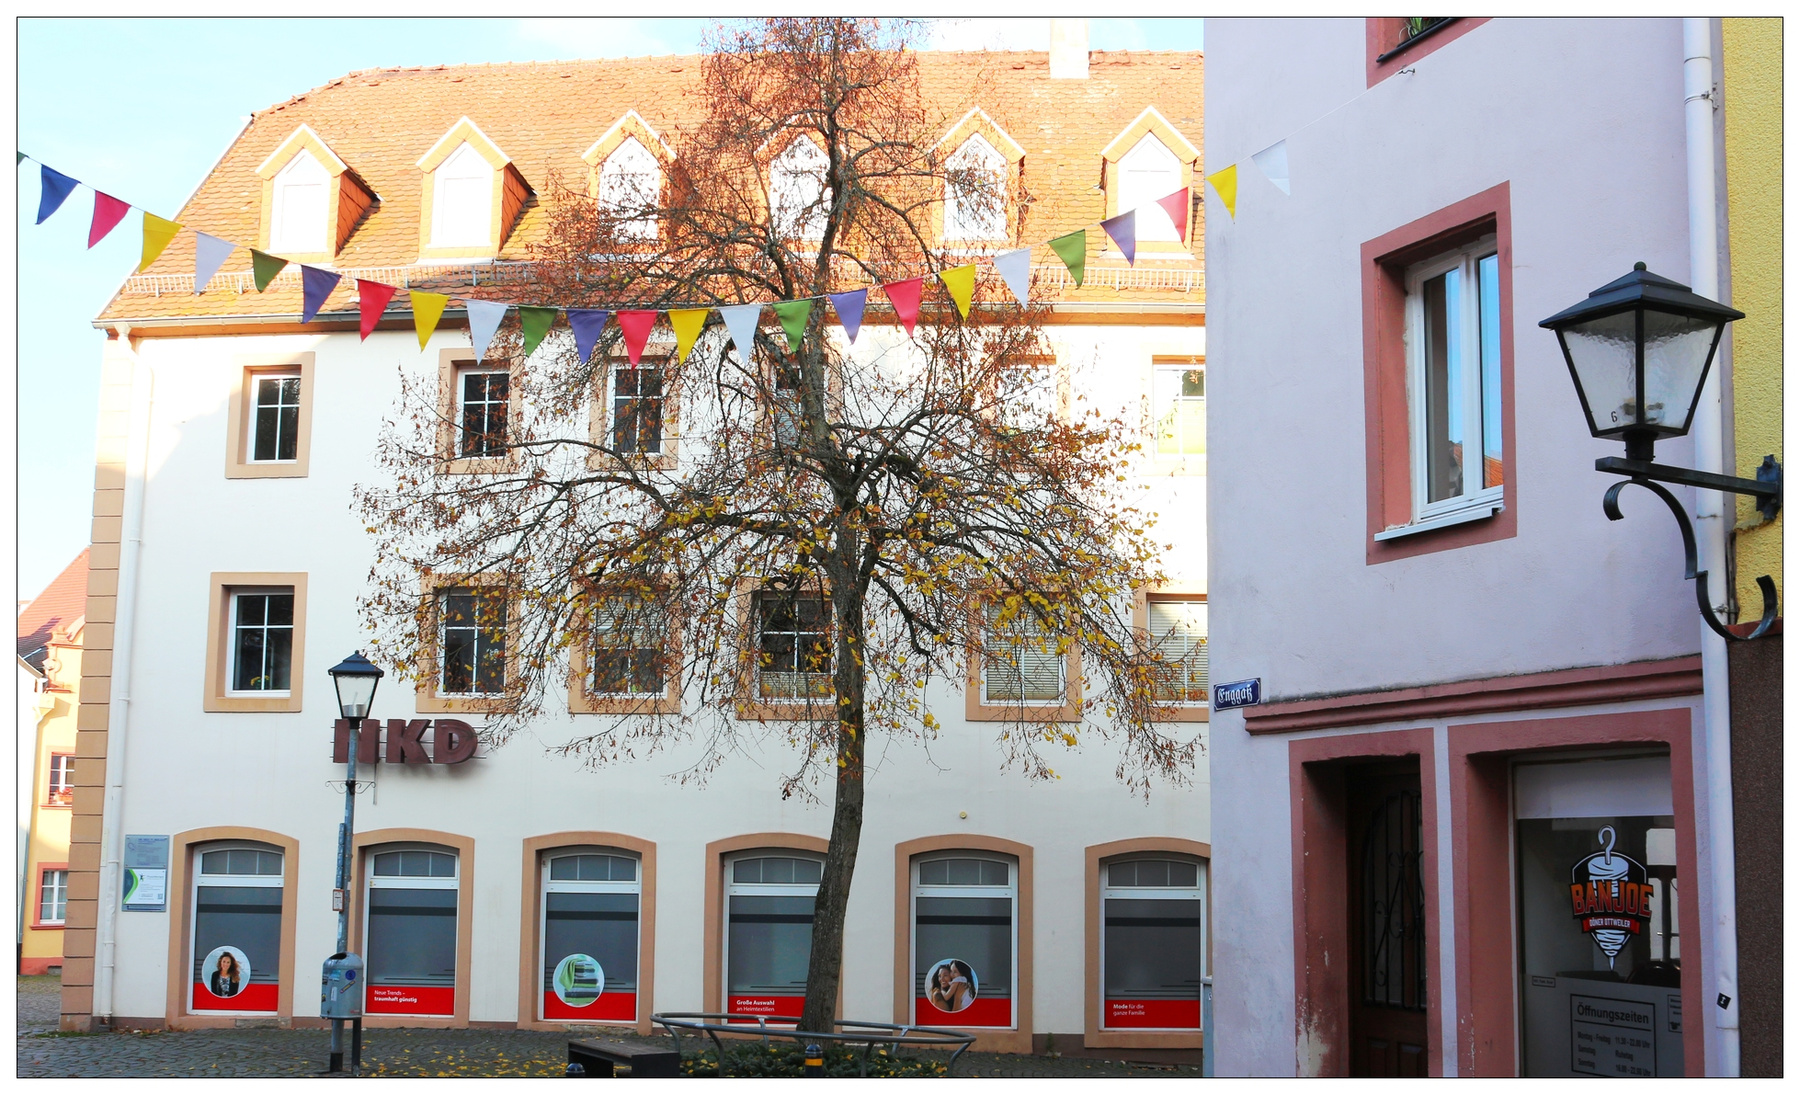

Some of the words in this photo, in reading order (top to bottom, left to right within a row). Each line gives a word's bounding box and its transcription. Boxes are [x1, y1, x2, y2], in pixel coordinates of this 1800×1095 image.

[1217, 684, 1253, 705] Enggaß
[333, 719, 478, 764] NKD
[1570, 881, 1654, 918] BANJOE
[1589, 917, 1604, 927] DÖNER
[1605, 918, 1631, 928] OTTWEILER
[1577, 1002, 1649, 1024] Öffnungszeiten
[1577, 1031, 1593, 1042] Montag
[1595, 1033, 1611, 1045] Freitag
[1642, 1040, 1651, 1049] Uhr
[1615, 1049, 1634, 1062] Ruhetag
[1642, 1068, 1651, 1076] Uhr
